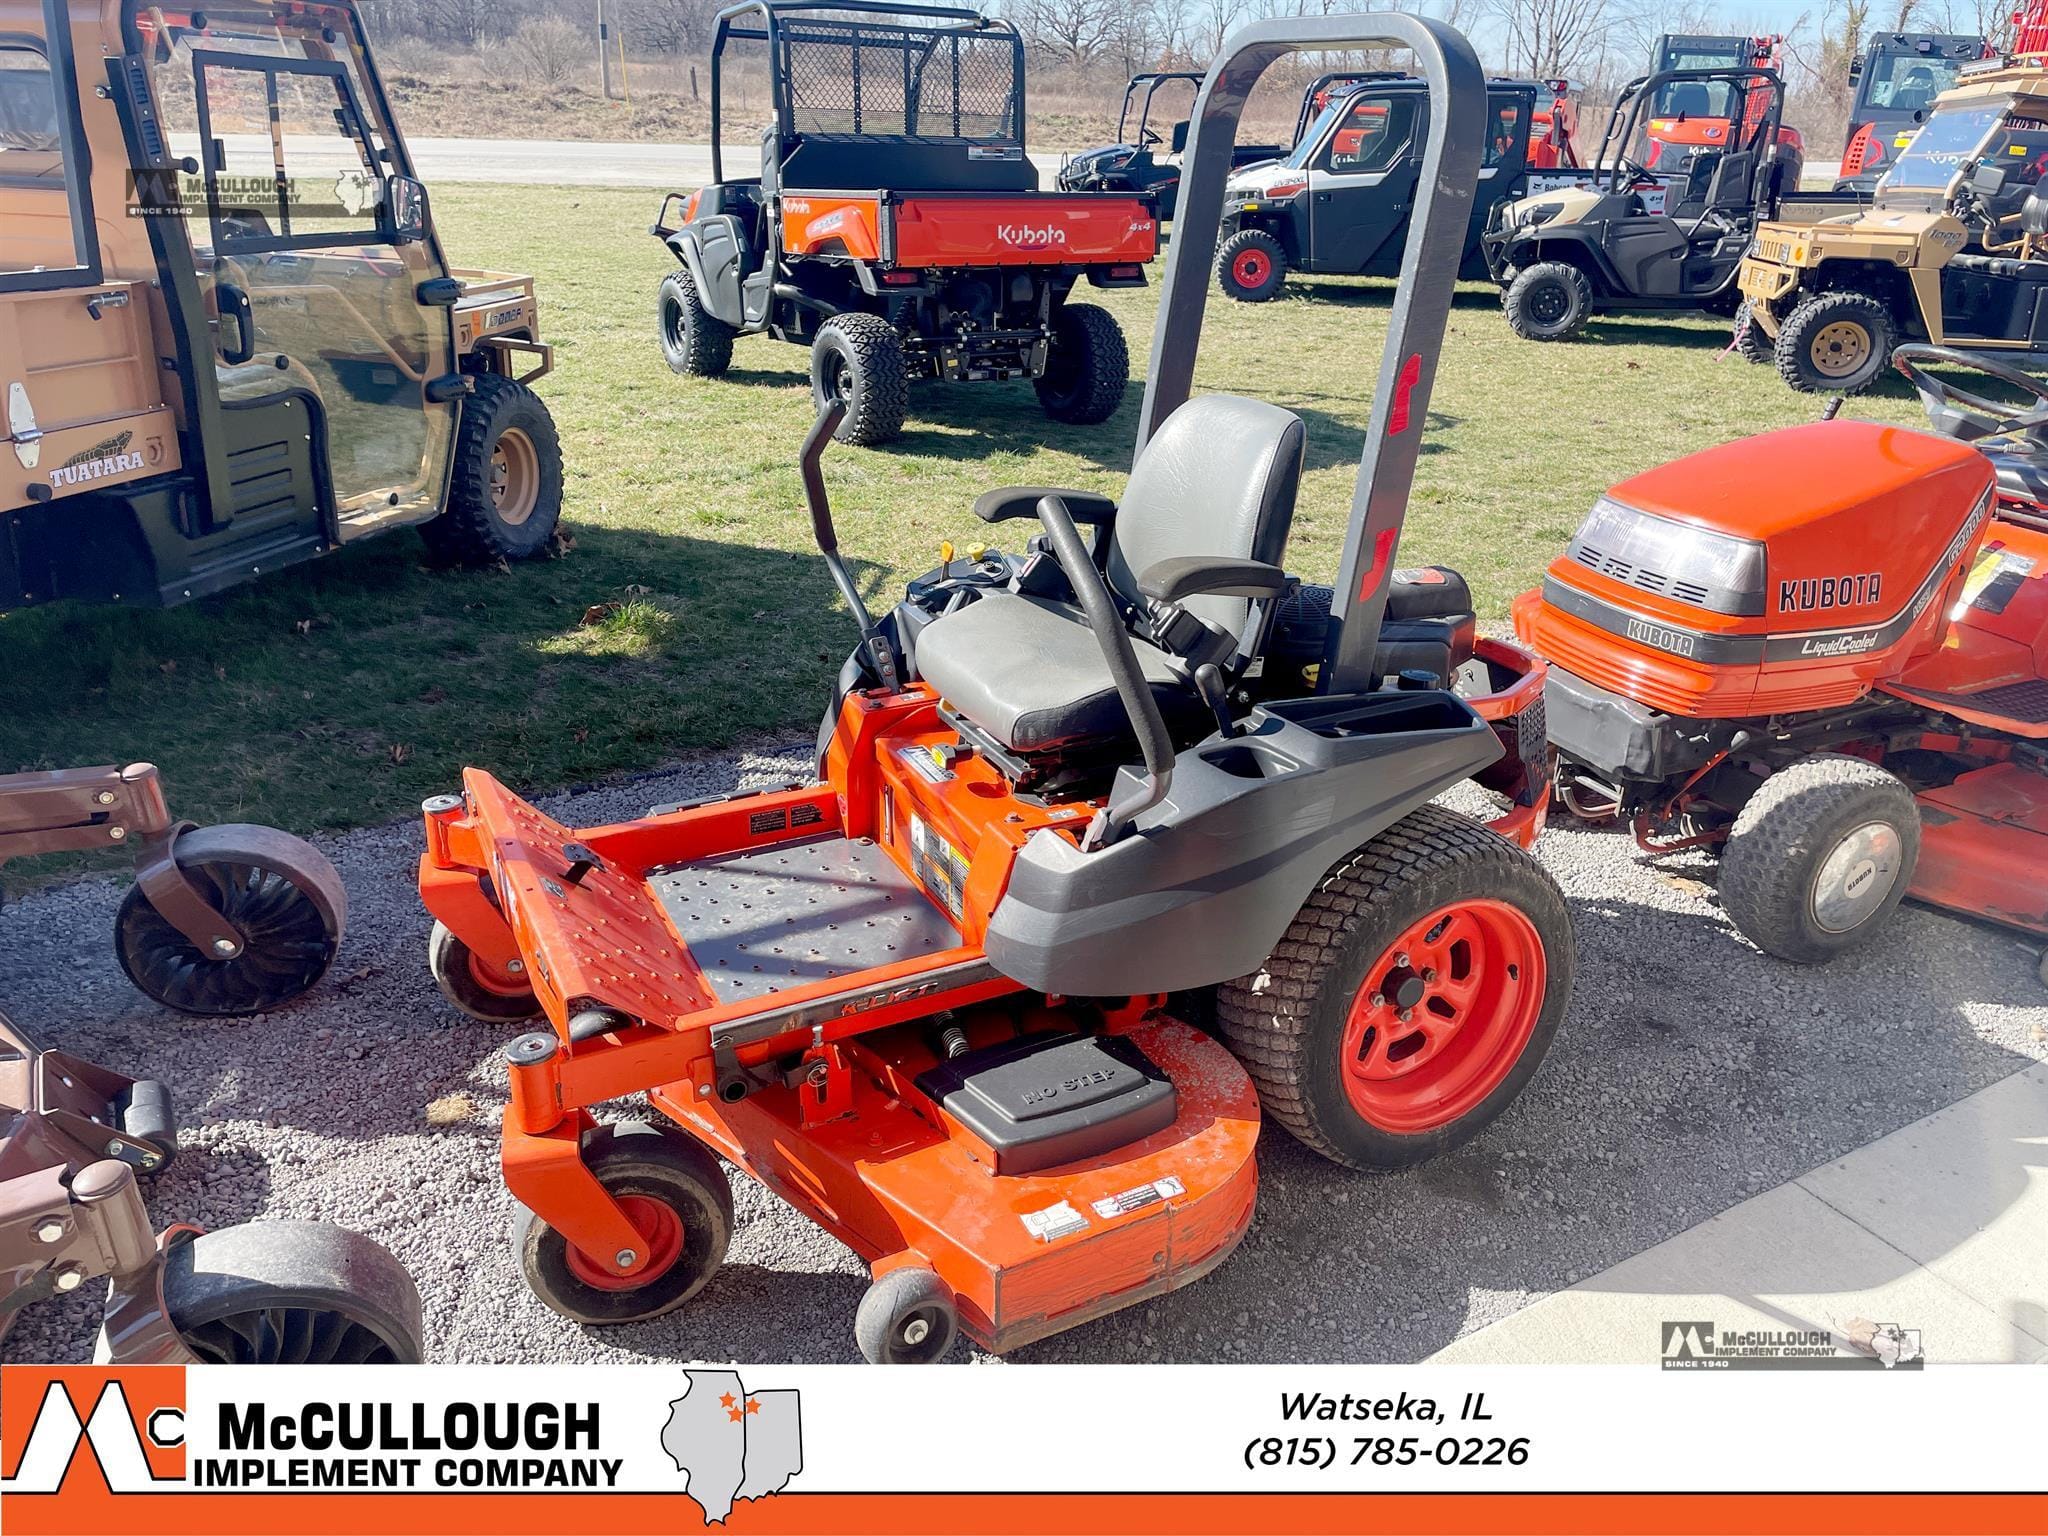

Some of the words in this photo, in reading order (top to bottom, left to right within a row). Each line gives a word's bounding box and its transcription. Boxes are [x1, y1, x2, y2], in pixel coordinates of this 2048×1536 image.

[997, 224, 1066, 245] Kubota
[1129, 222, 1152, 232] 4x4
[49, 451, 145, 488] TUATARA
[1778, 572, 1883, 614] KUBOTA
[1626, 618, 1694, 657] KUBOTA
[1847, 867, 1872, 891] KUBOTA
[1021, 1087, 1058, 1105] NO
[1060, 1069, 1115, 1092] STEP
